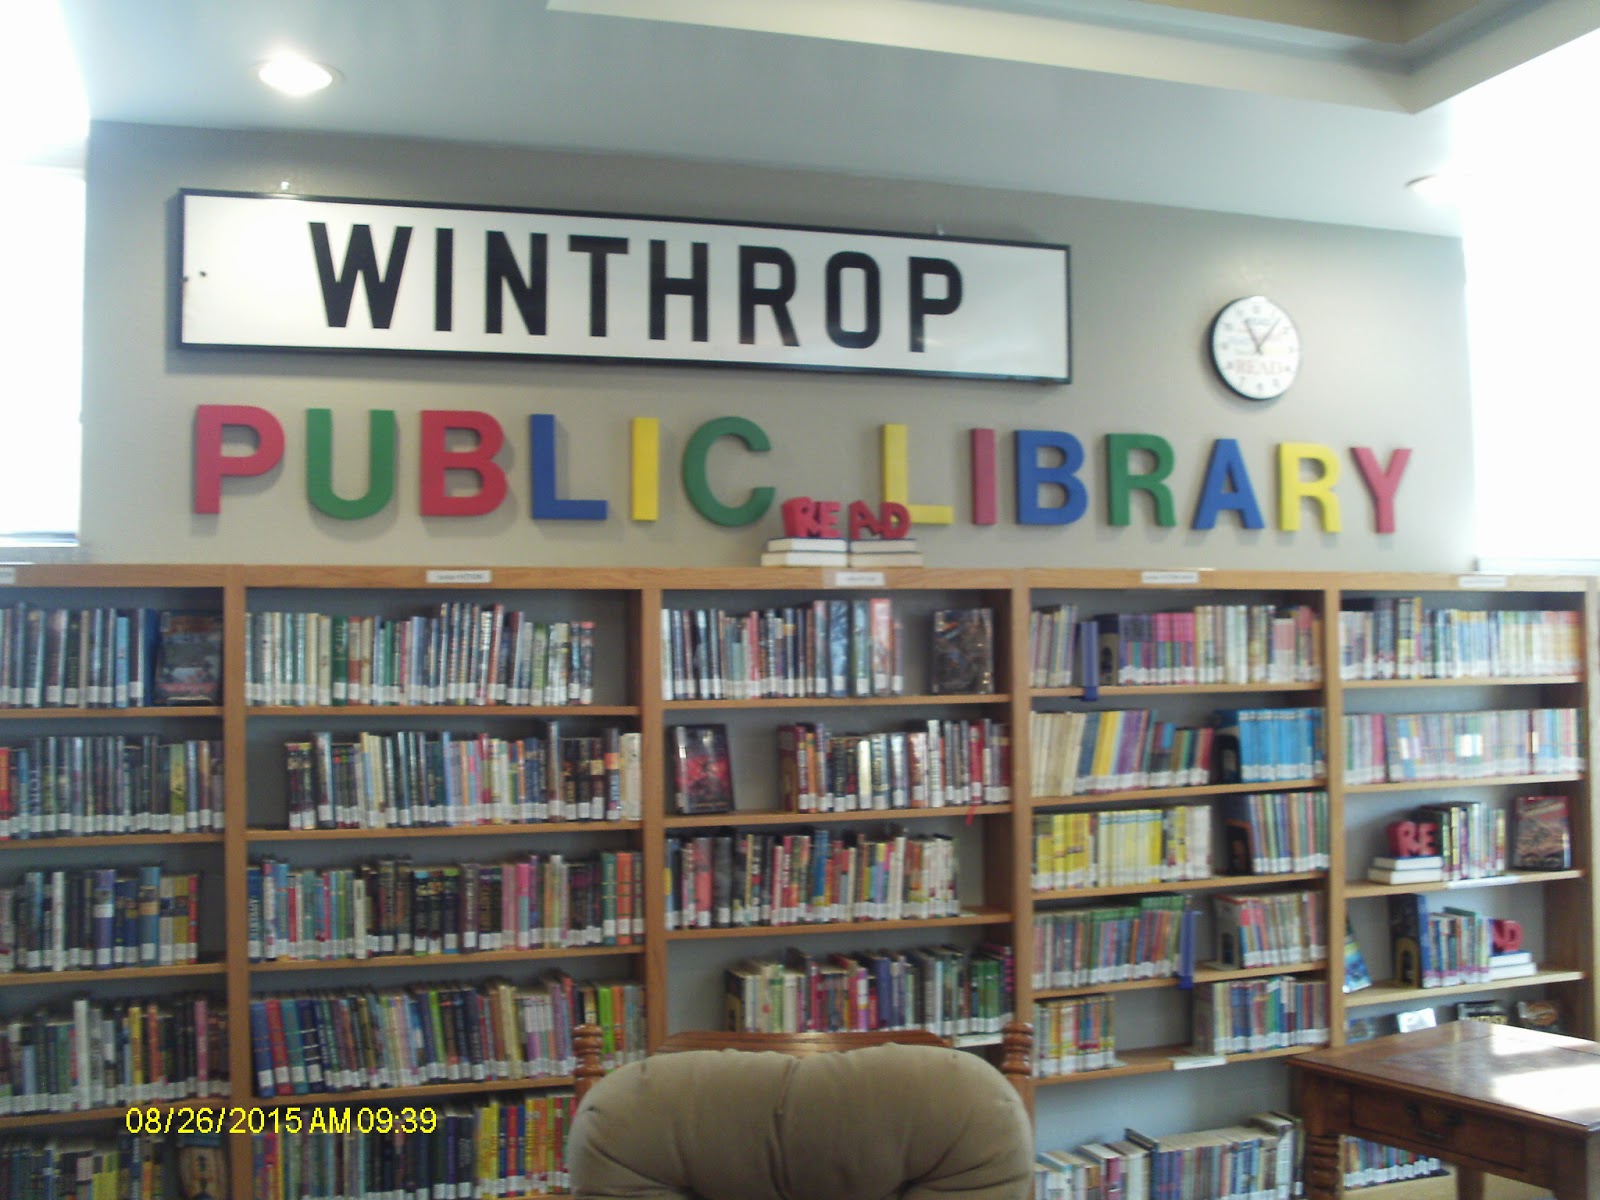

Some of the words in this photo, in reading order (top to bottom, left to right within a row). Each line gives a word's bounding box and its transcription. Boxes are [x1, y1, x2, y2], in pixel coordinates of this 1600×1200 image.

[309, 222, 963, 353] WINTHROP
[195, 404, 775, 527] PUBLIC
[880, 423, 1412, 534] LIBRARY
